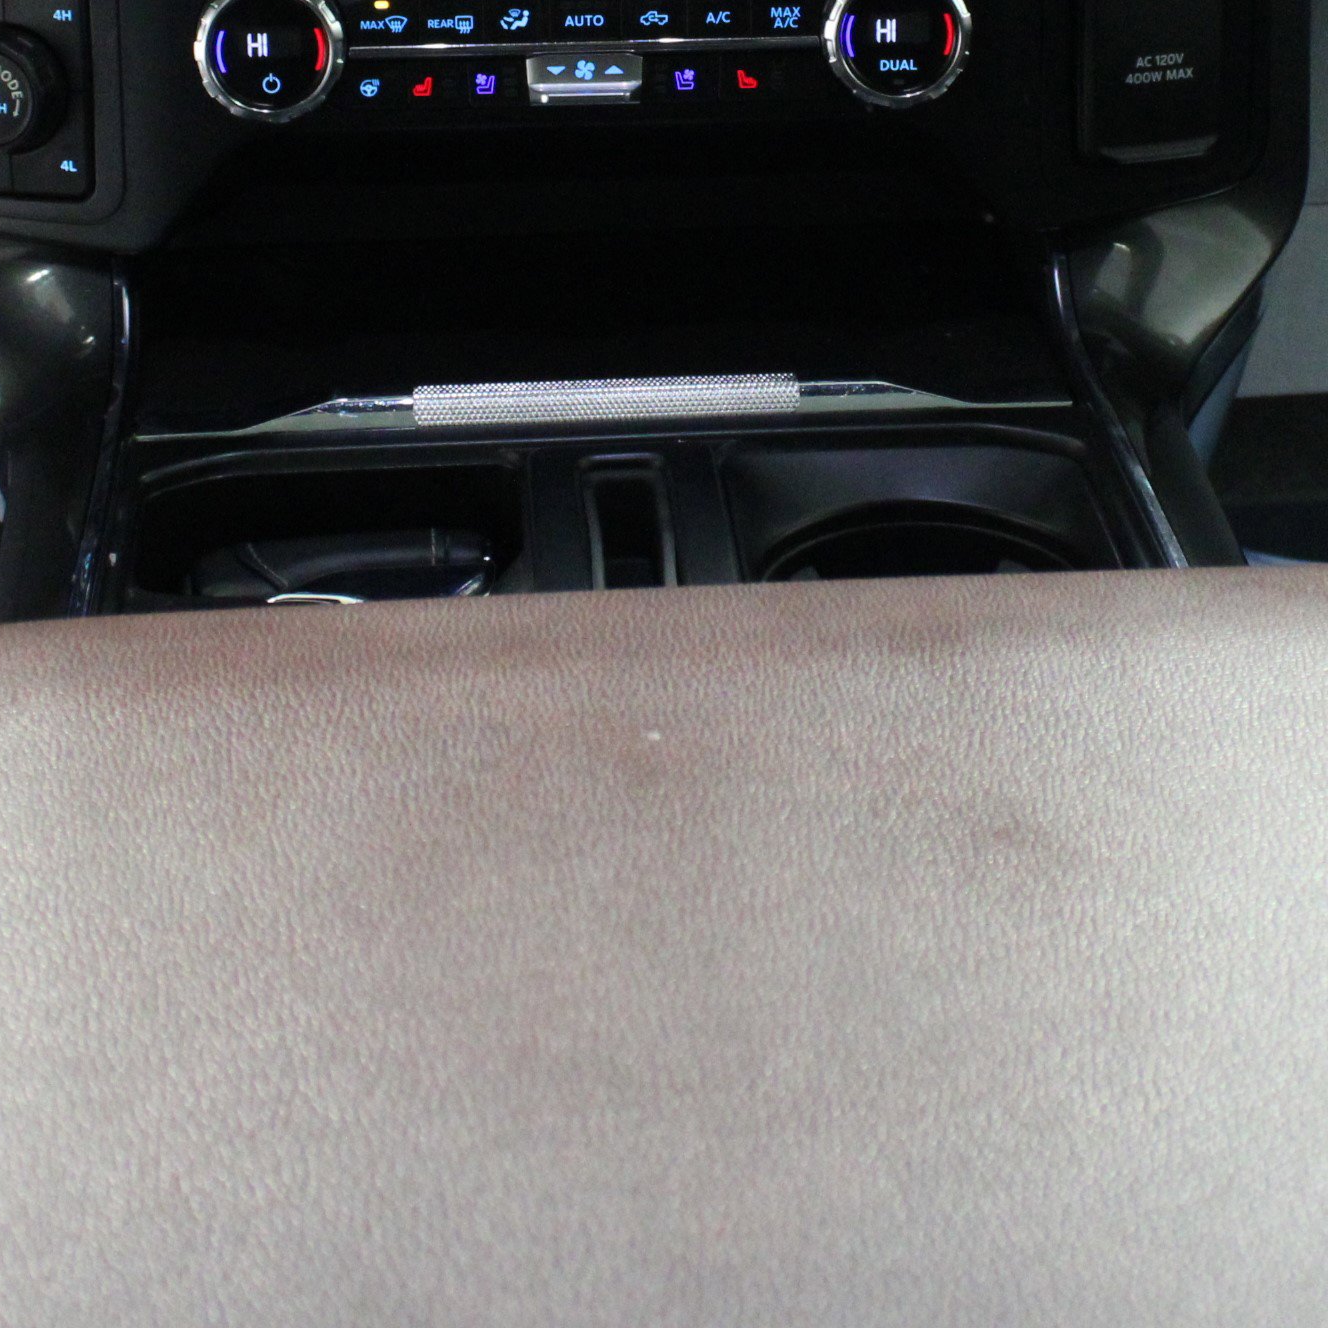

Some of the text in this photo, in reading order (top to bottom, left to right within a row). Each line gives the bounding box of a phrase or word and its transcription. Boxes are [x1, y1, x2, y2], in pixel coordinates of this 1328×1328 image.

[52, 9, 72, 22] 4H
[705, 10, 732, 25] A/C
[770, 6, 802, 19] MAX
[360, 19, 386, 31] MAX
[427, 18, 455, 30] REAR
[564, 14, 605, 28] AUTO
[773, 16, 800, 29] A/C
[879, 58, 918, 72] DUAL
[1136, 53, 1185, 69] AC 120V
[1125, 67, 1194, 85] 400W MAX
[59, 159, 78, 173] 4L
